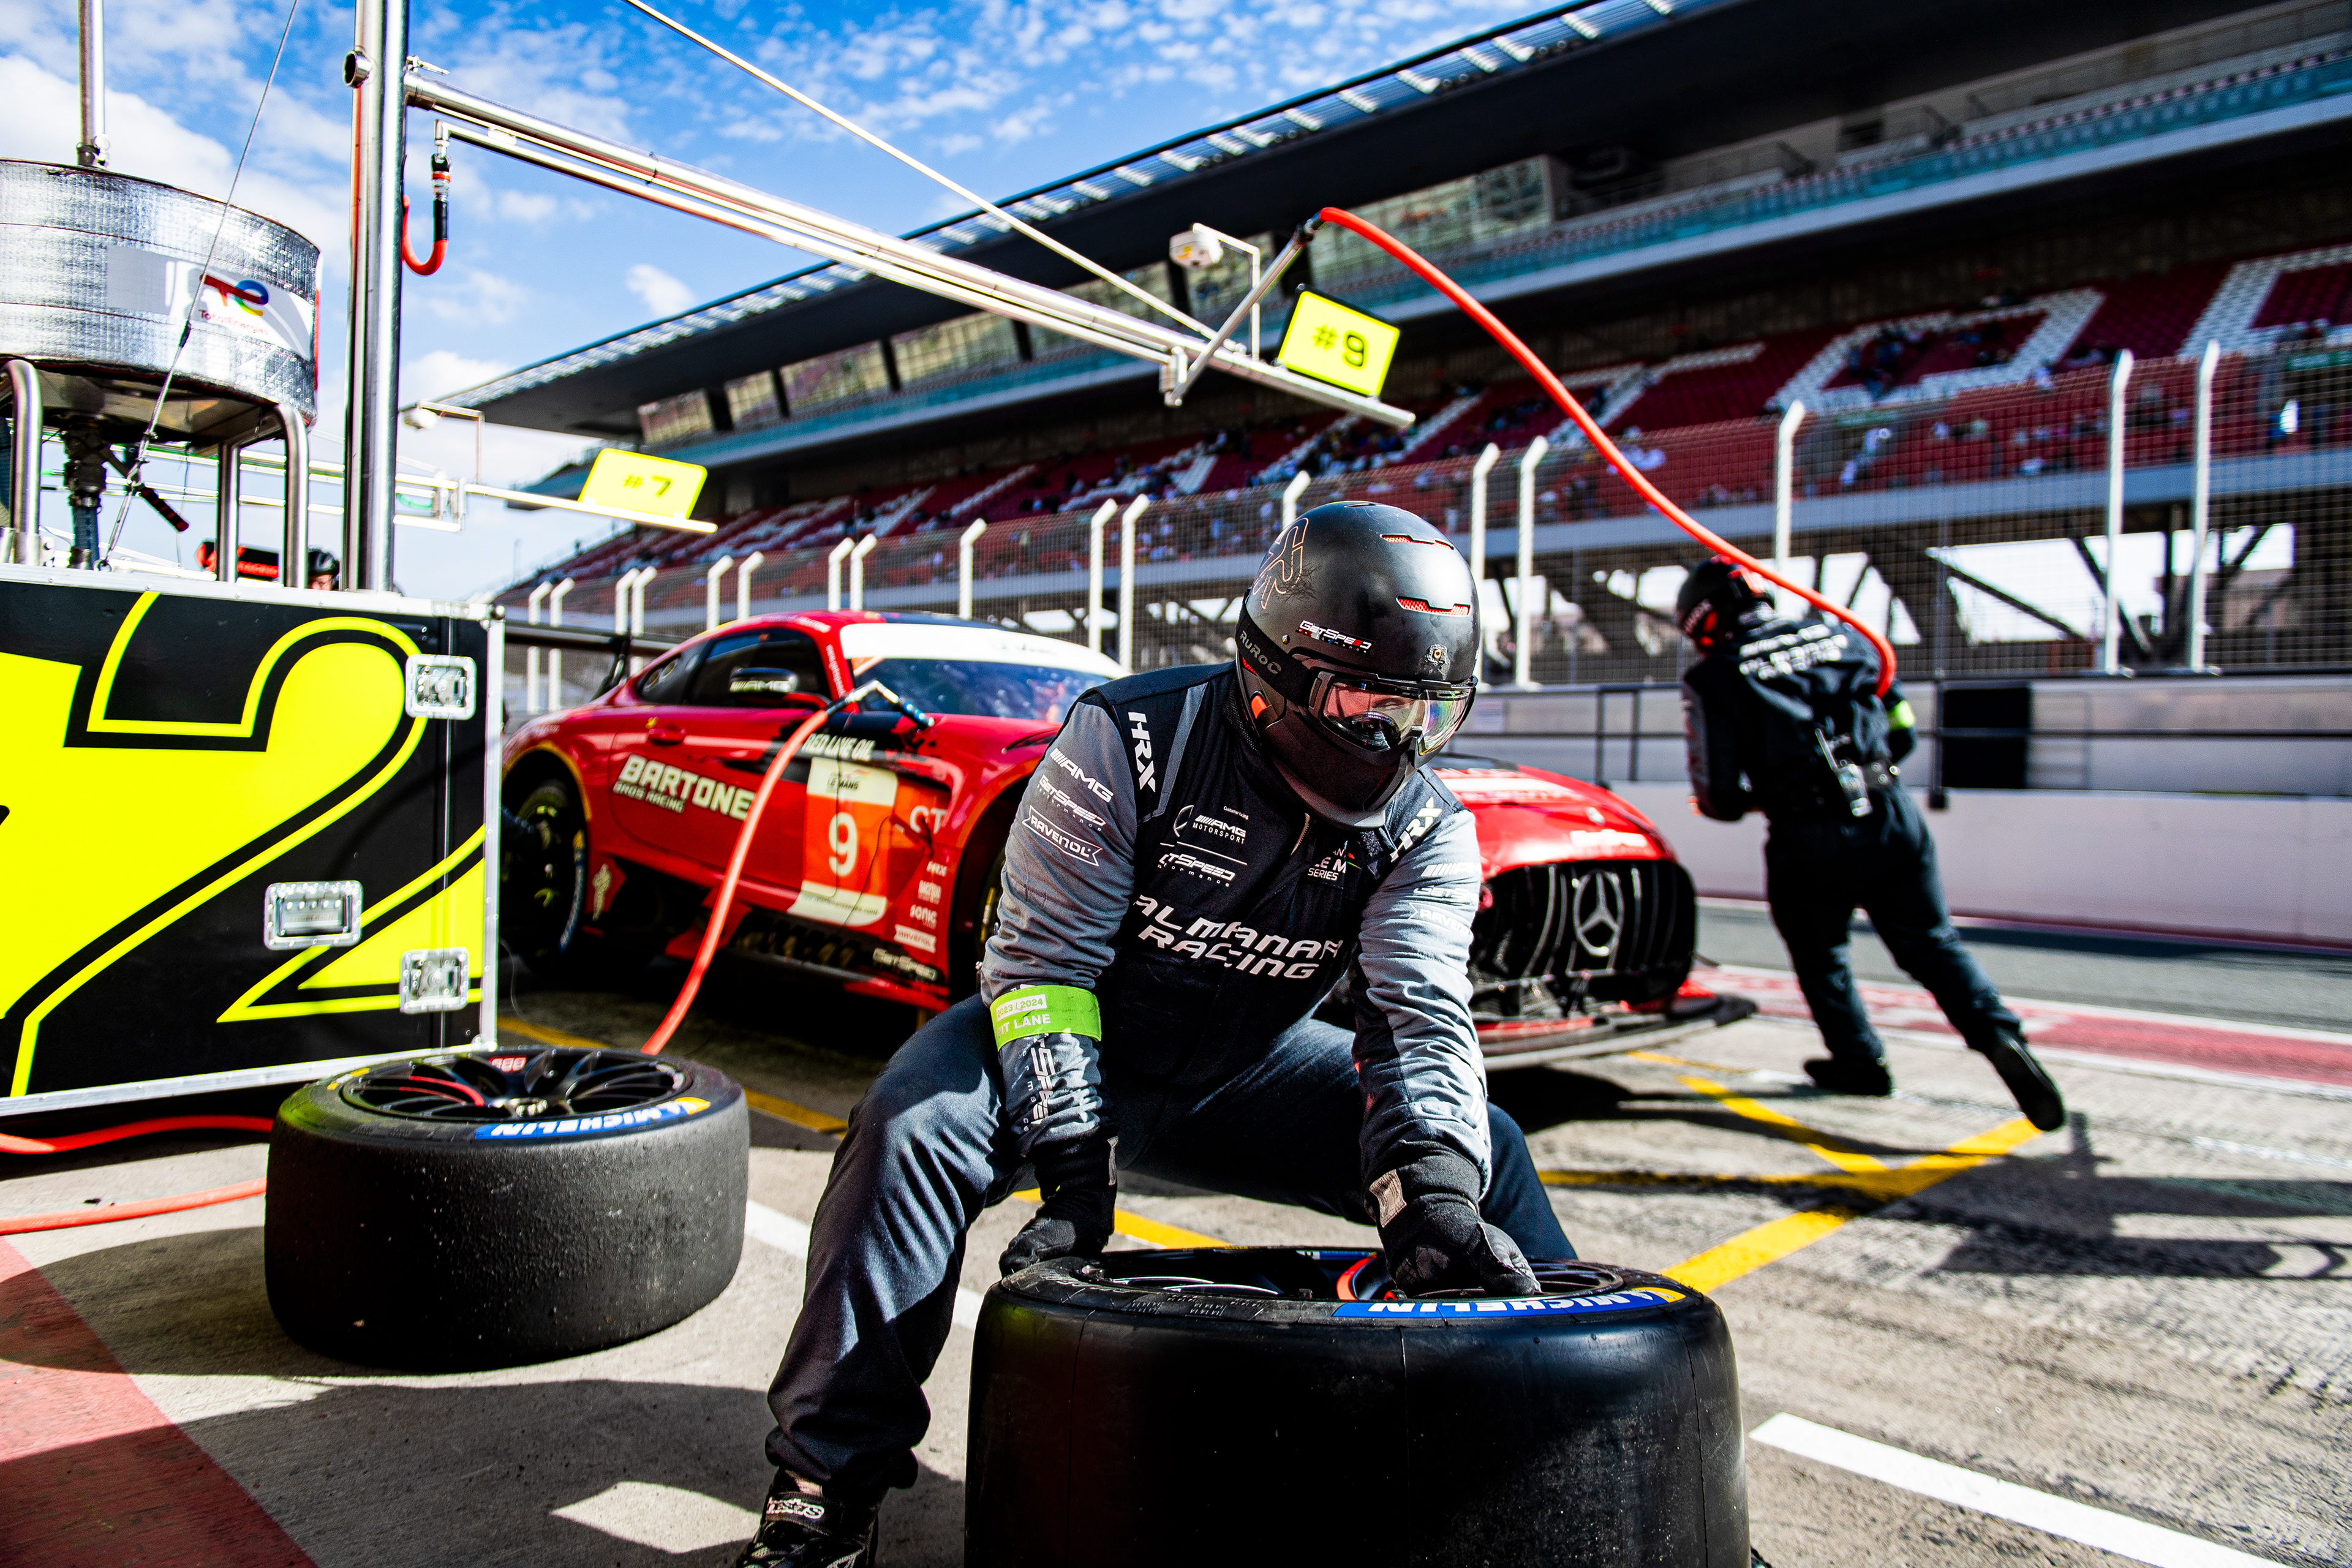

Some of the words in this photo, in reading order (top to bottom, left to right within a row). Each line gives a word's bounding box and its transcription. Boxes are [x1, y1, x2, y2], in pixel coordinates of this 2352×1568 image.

[1312, 324, 1368, 369] #9
[622, 474, 673, 497] #7
[746, 680, 791, 693] AMG
[801, 733, 831, 755] RED
[824, 735, 858, 759] LINE
[851, 739, 876, 762] OIL
[1128, 711, 1156, 793] HRX
[617, 753, 756, 821] BARTONE
[1060, 758, 1114, 803] AMG
[1030, 815, 1091, 858] RAVENOL
[1192, 821, 1245, 845] MOTORSPORT
[1211, 820, 1246, 838] AMG
[828, 812, 858, 877] 9
[1307, 867, 1339, 881] SERIES
[1138, 924, 1320, 979] RACING
[997, 1004, 1013, 1018] 2023
[1020, 998, 1043, 1009] 2024
[997, 1022, 1010, 1039] PIT
[1014, 1014, 1051, 1030] LANE
[491, 1109, 662, 1136] MICHELIN
[1368, 1293, 1630, 1313] MICHELIN
